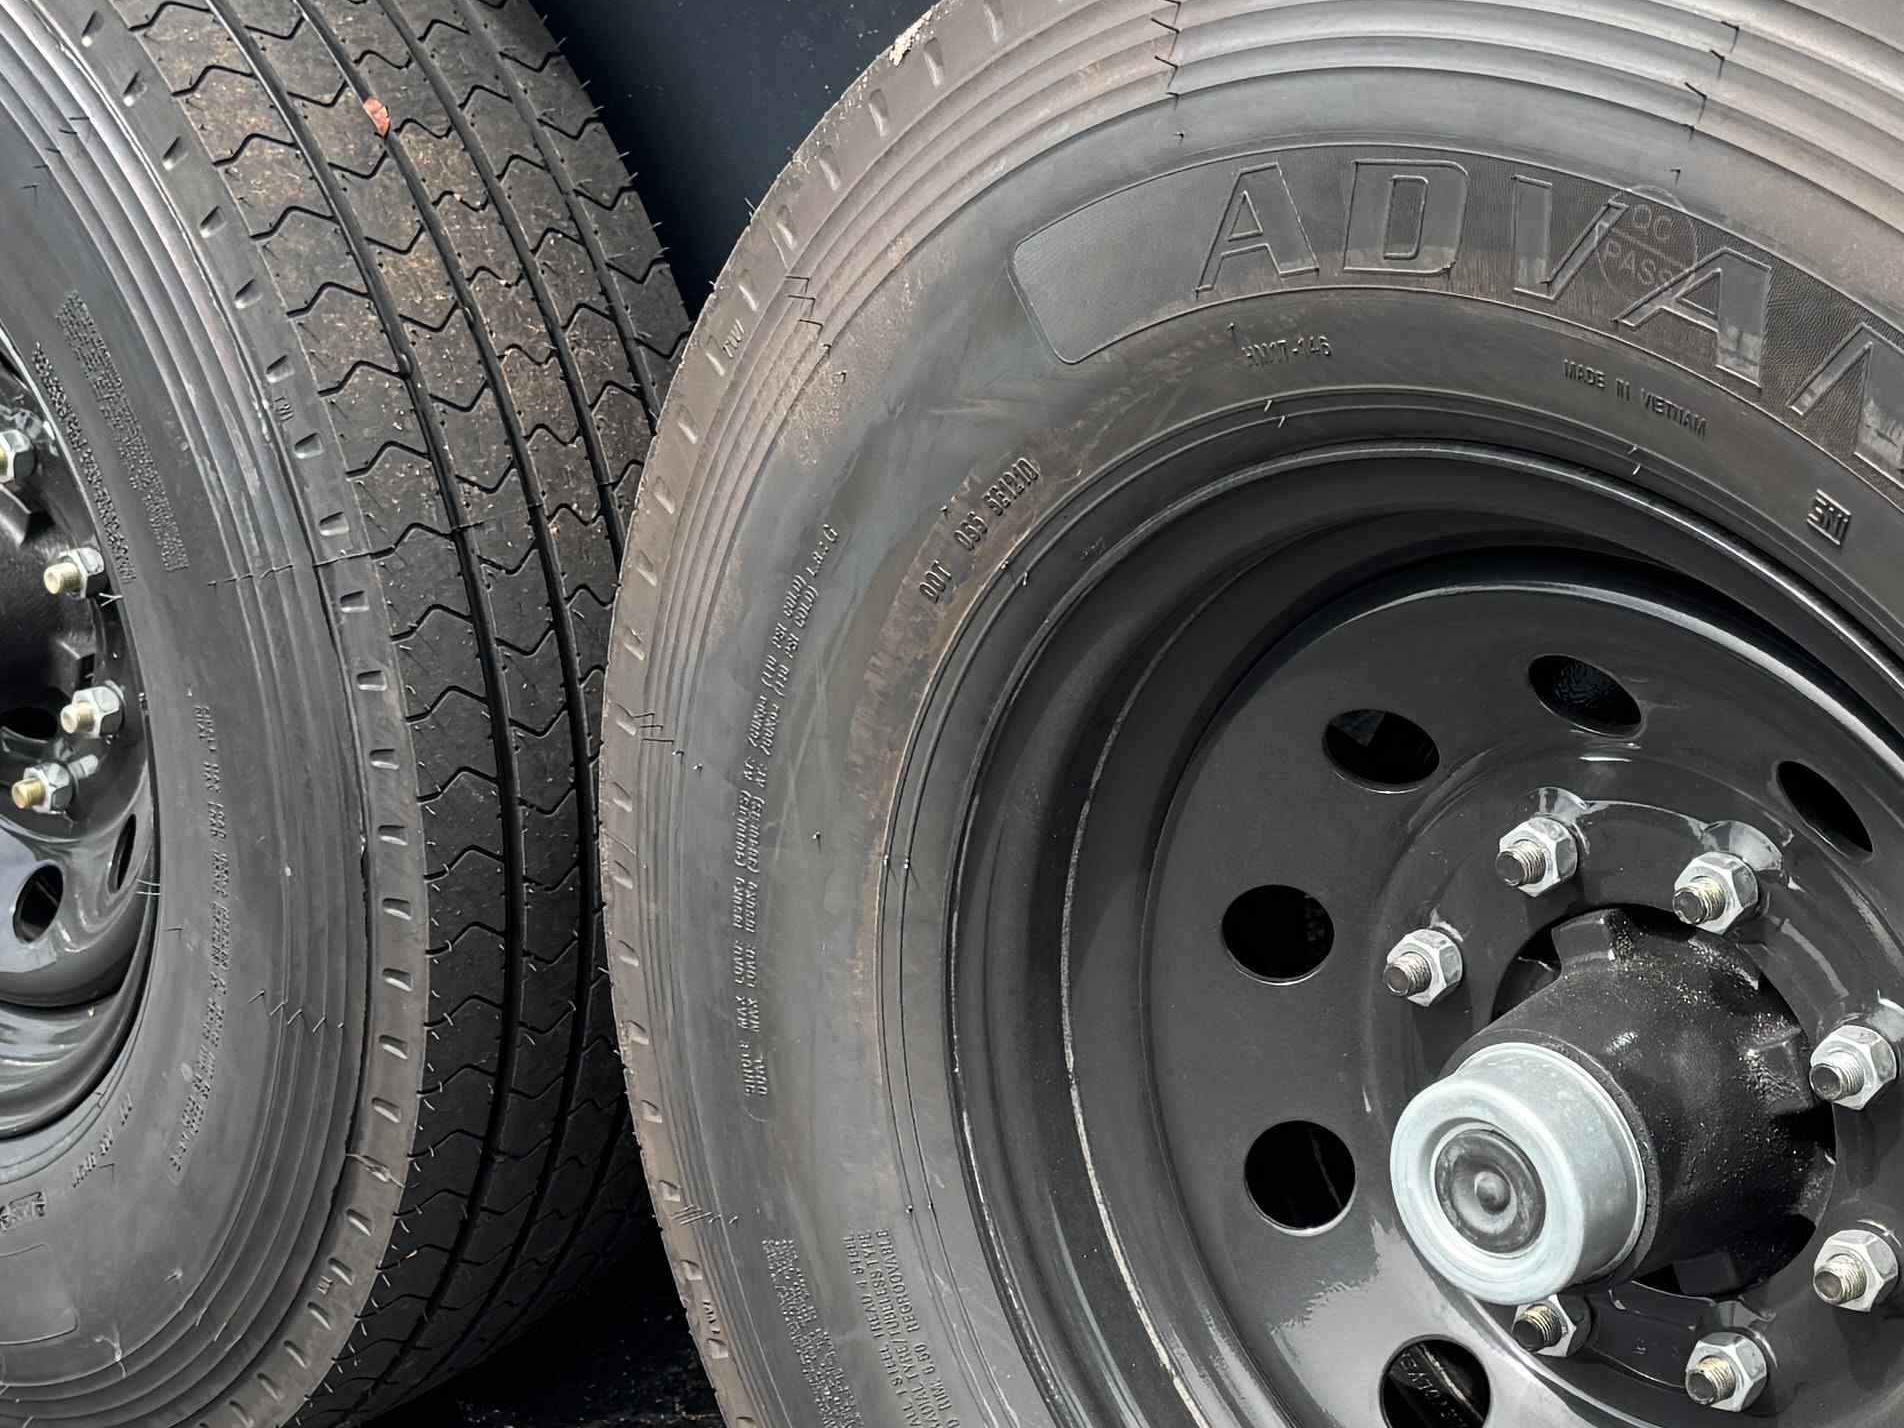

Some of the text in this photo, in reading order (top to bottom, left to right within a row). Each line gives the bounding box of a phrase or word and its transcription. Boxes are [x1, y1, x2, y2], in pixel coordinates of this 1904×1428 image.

[1562, 359, 1709, 438] MADE IN VIETNAM
[920, 559, 952, 603] DOT
[876, 1229, 921, 1333] REGROOVABLE
